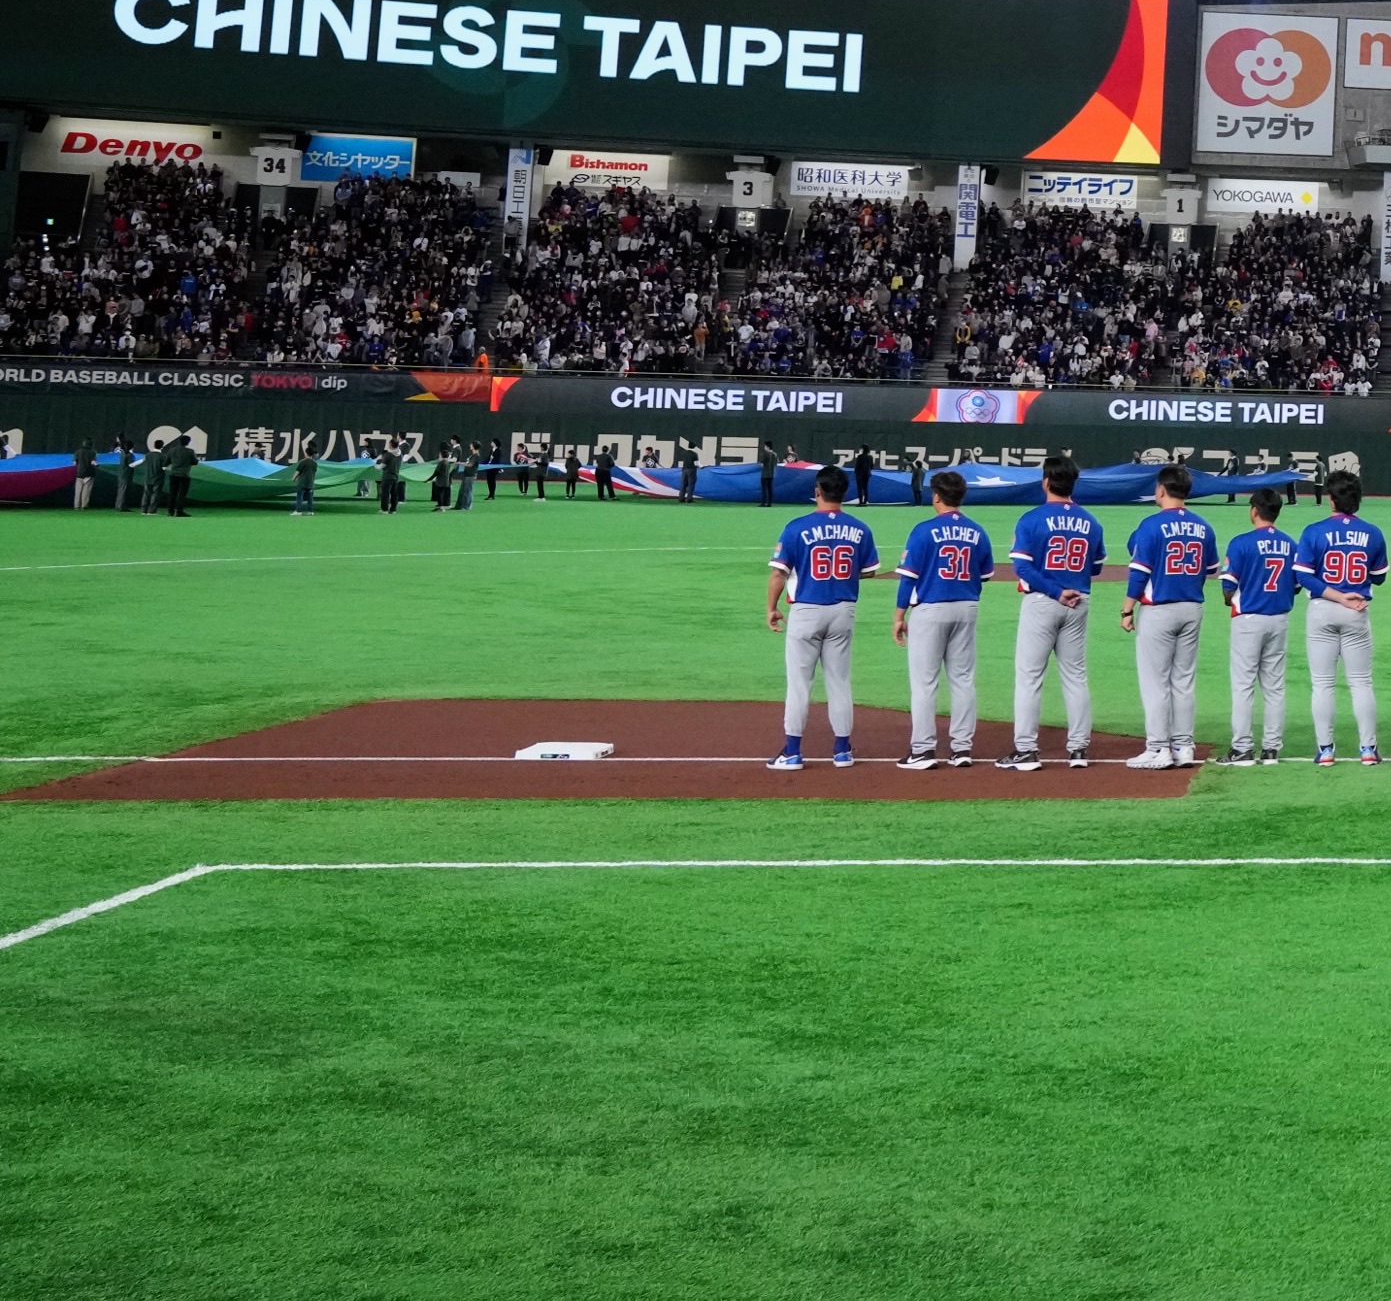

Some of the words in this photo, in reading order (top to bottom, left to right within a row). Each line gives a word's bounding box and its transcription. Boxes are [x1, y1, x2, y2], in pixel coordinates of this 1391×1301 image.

[583, 15, 864, 93] TAIPEI
[1216, 113, 1314, 140] シマダヤ
[60, 131, 203, 160] Denyo
[263, 157, 286, 174] 34
[569, 154, 648, 171] Bishamon
[743, 181, 753, 196] 3
[797, 167, 901, 187] 昭和医科大学
[1028, 175, 1134, 195] ニッテイライフ
[1176, 199, 1184, 213] 1
[1213, 189, 1294, 204] YOKOGAWA
[956, 183, 978, 238] 関電工
[50, 369, 156, 386] BASEBALL
[159, 372, 244, 387] CLASSIC
[251, 374, 313, 389] TOKYO
[321, 375, 348, 390] dip
[610, 386, 745, 411] CHINESE
[751, 389, 843, 414] TAIPEI
[1108, 399, 1232, 423] CHINESE
[1237, 401, 1325, 425] TAIPEI
[801, 524, 864, 545] C.M.CHANG
[931, 525, 981, 545] C.H.CHEN
[1161, 521, 1206, 540] C.M.PENG
[1325, 530, 1369, 548] Y.L.SUN
[810, 545, 855, 580] 66
[938, 545, 971, 581] 31
[1045, 535, 1089, 572] 28
[1165, 541, 1203, 575] 23
[1264, 558, 1285, 592] 7
[1322, 550, 1368, 585] 96
